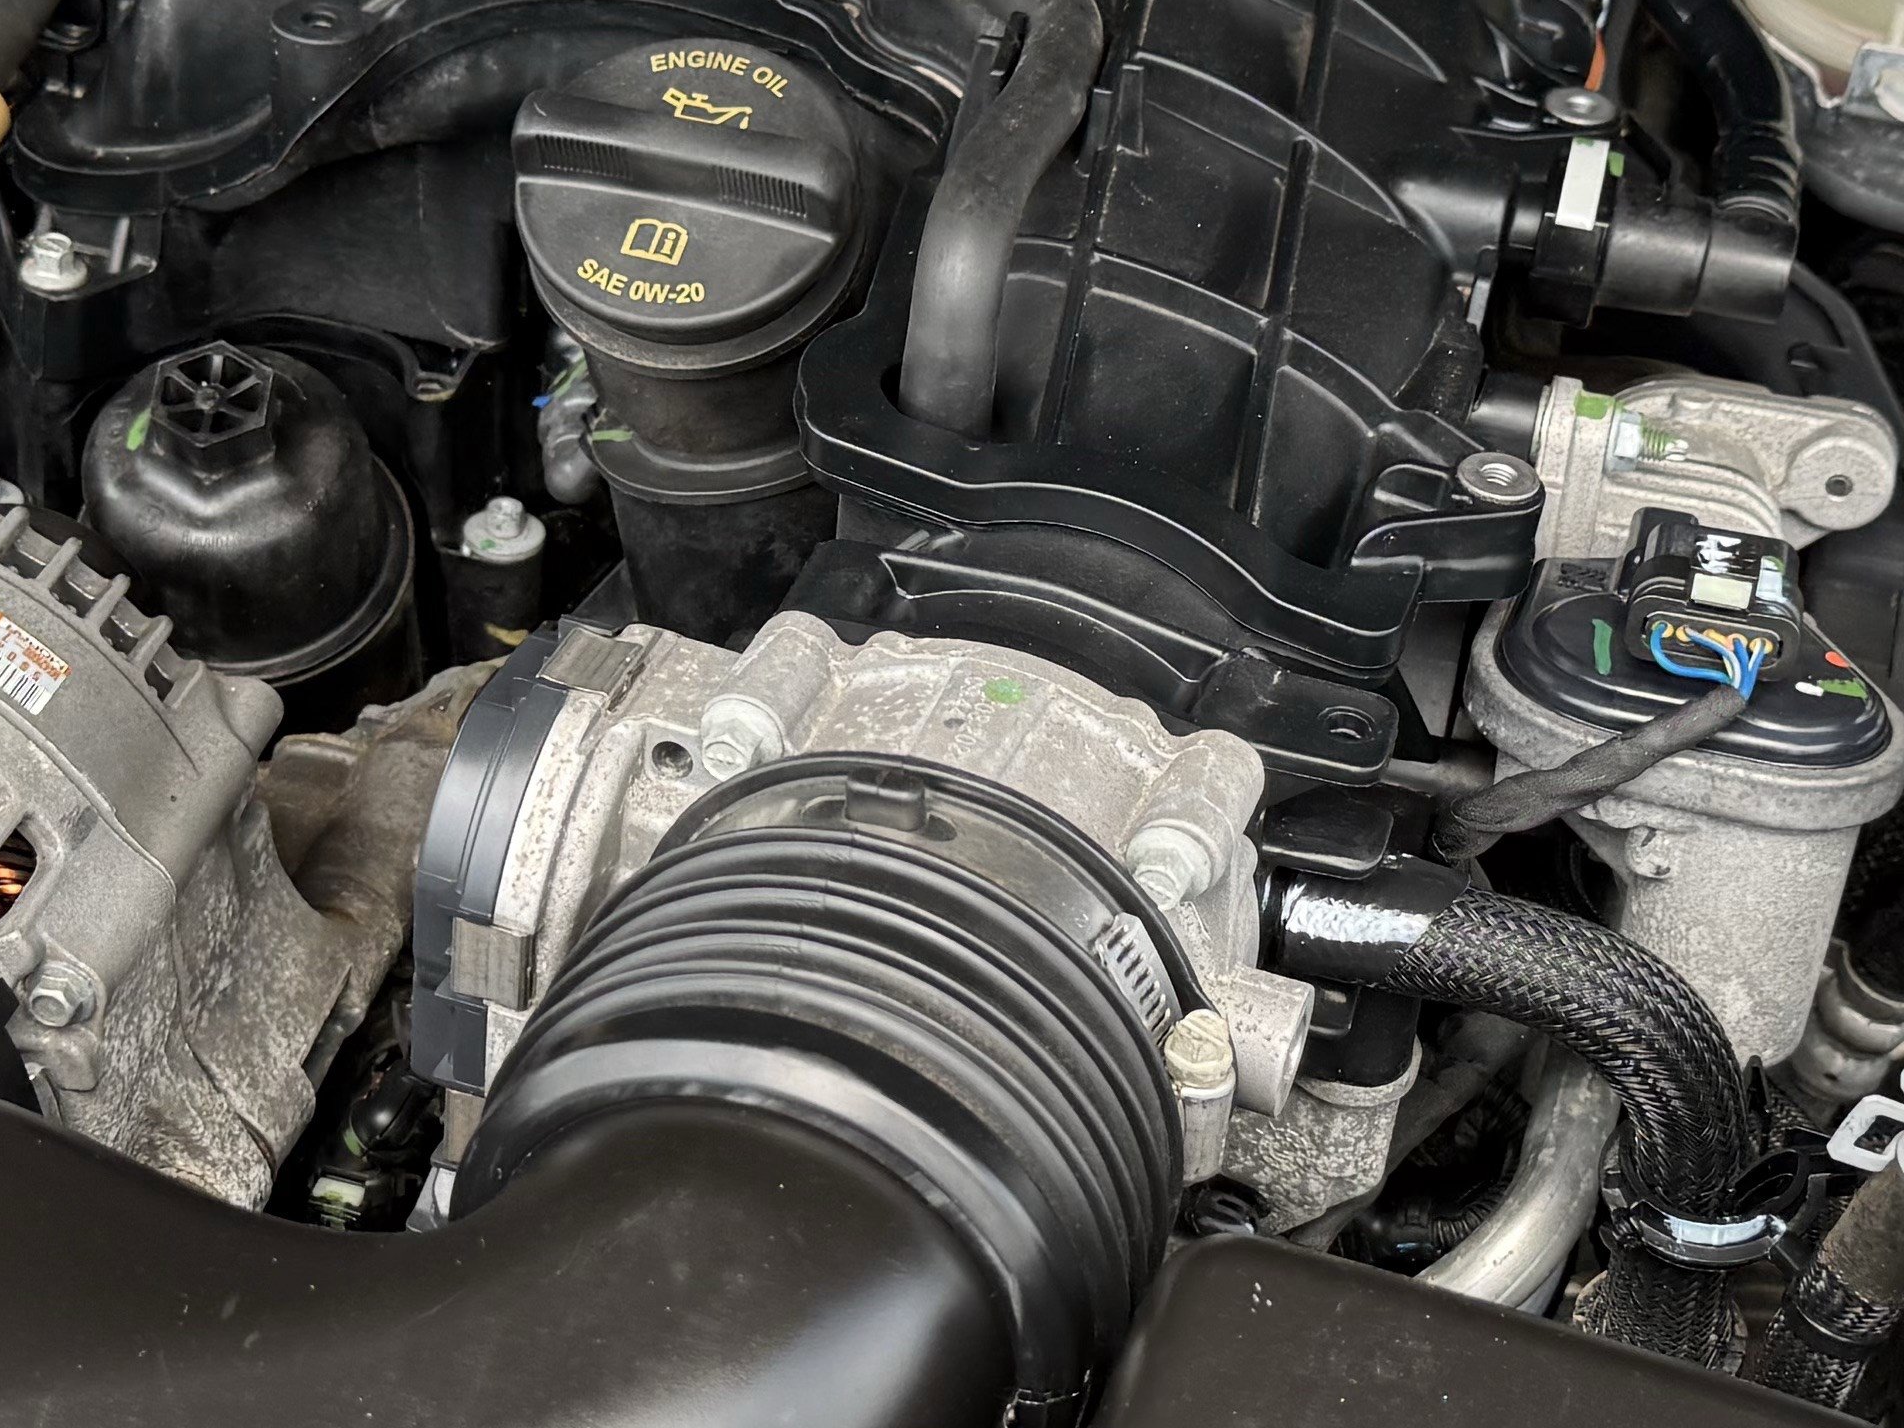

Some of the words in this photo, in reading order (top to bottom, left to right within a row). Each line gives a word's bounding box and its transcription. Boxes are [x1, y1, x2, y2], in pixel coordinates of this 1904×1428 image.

[650, 50, 751, 76] ENGINE
[752, 66, 789, 98] OIL
[576, 258, 628, 297] SAE
[628, 280, 706, 304] 0W-20
